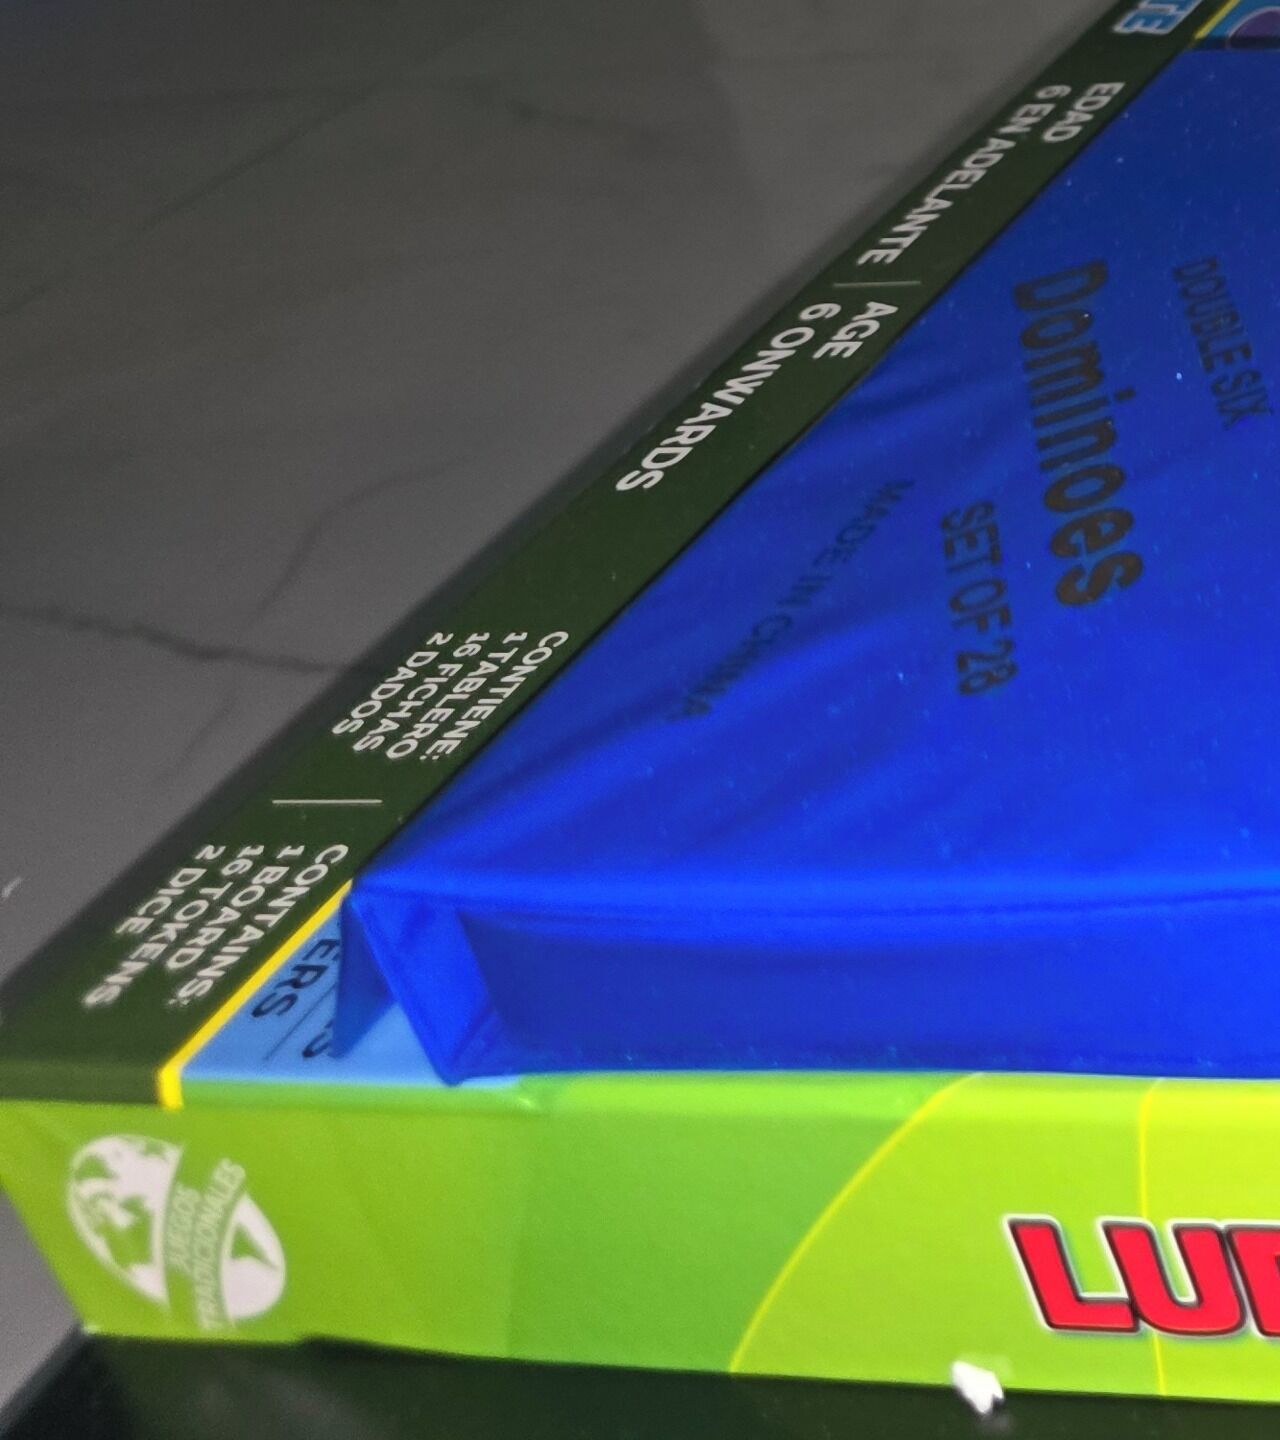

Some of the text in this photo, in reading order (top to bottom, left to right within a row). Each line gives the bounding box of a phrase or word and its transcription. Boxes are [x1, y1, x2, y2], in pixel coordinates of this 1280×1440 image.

[858, 85, 1072, 266] 6 EN ADELANTE
[1042, 80, 1124, 141] EDAD
[814, 302, 898, 360] AGE
[1174, 257, 1274, 431] DOUBLE SIX
[616, 302, 841, 492] 6 ONWARDS
[1015, 261, 1145, 606] Dominoes
[940, 501, 1018, 696] SET OF 28
[332, 631, 453, 737] 2 DADOS
[353, 633, 489, 752] 16 FICHAS
[387, 649, 502, 759] TABLERO
[419, 631, 569, 762] CONTIENE:
[82, 845, 265, 1010] 16 TOKENS
[115, 845, 225, 936] 2 DICE
[164, 845, 305, 969] 1 BOARD
[166, 845, 349, 1008] CONTAINS:
